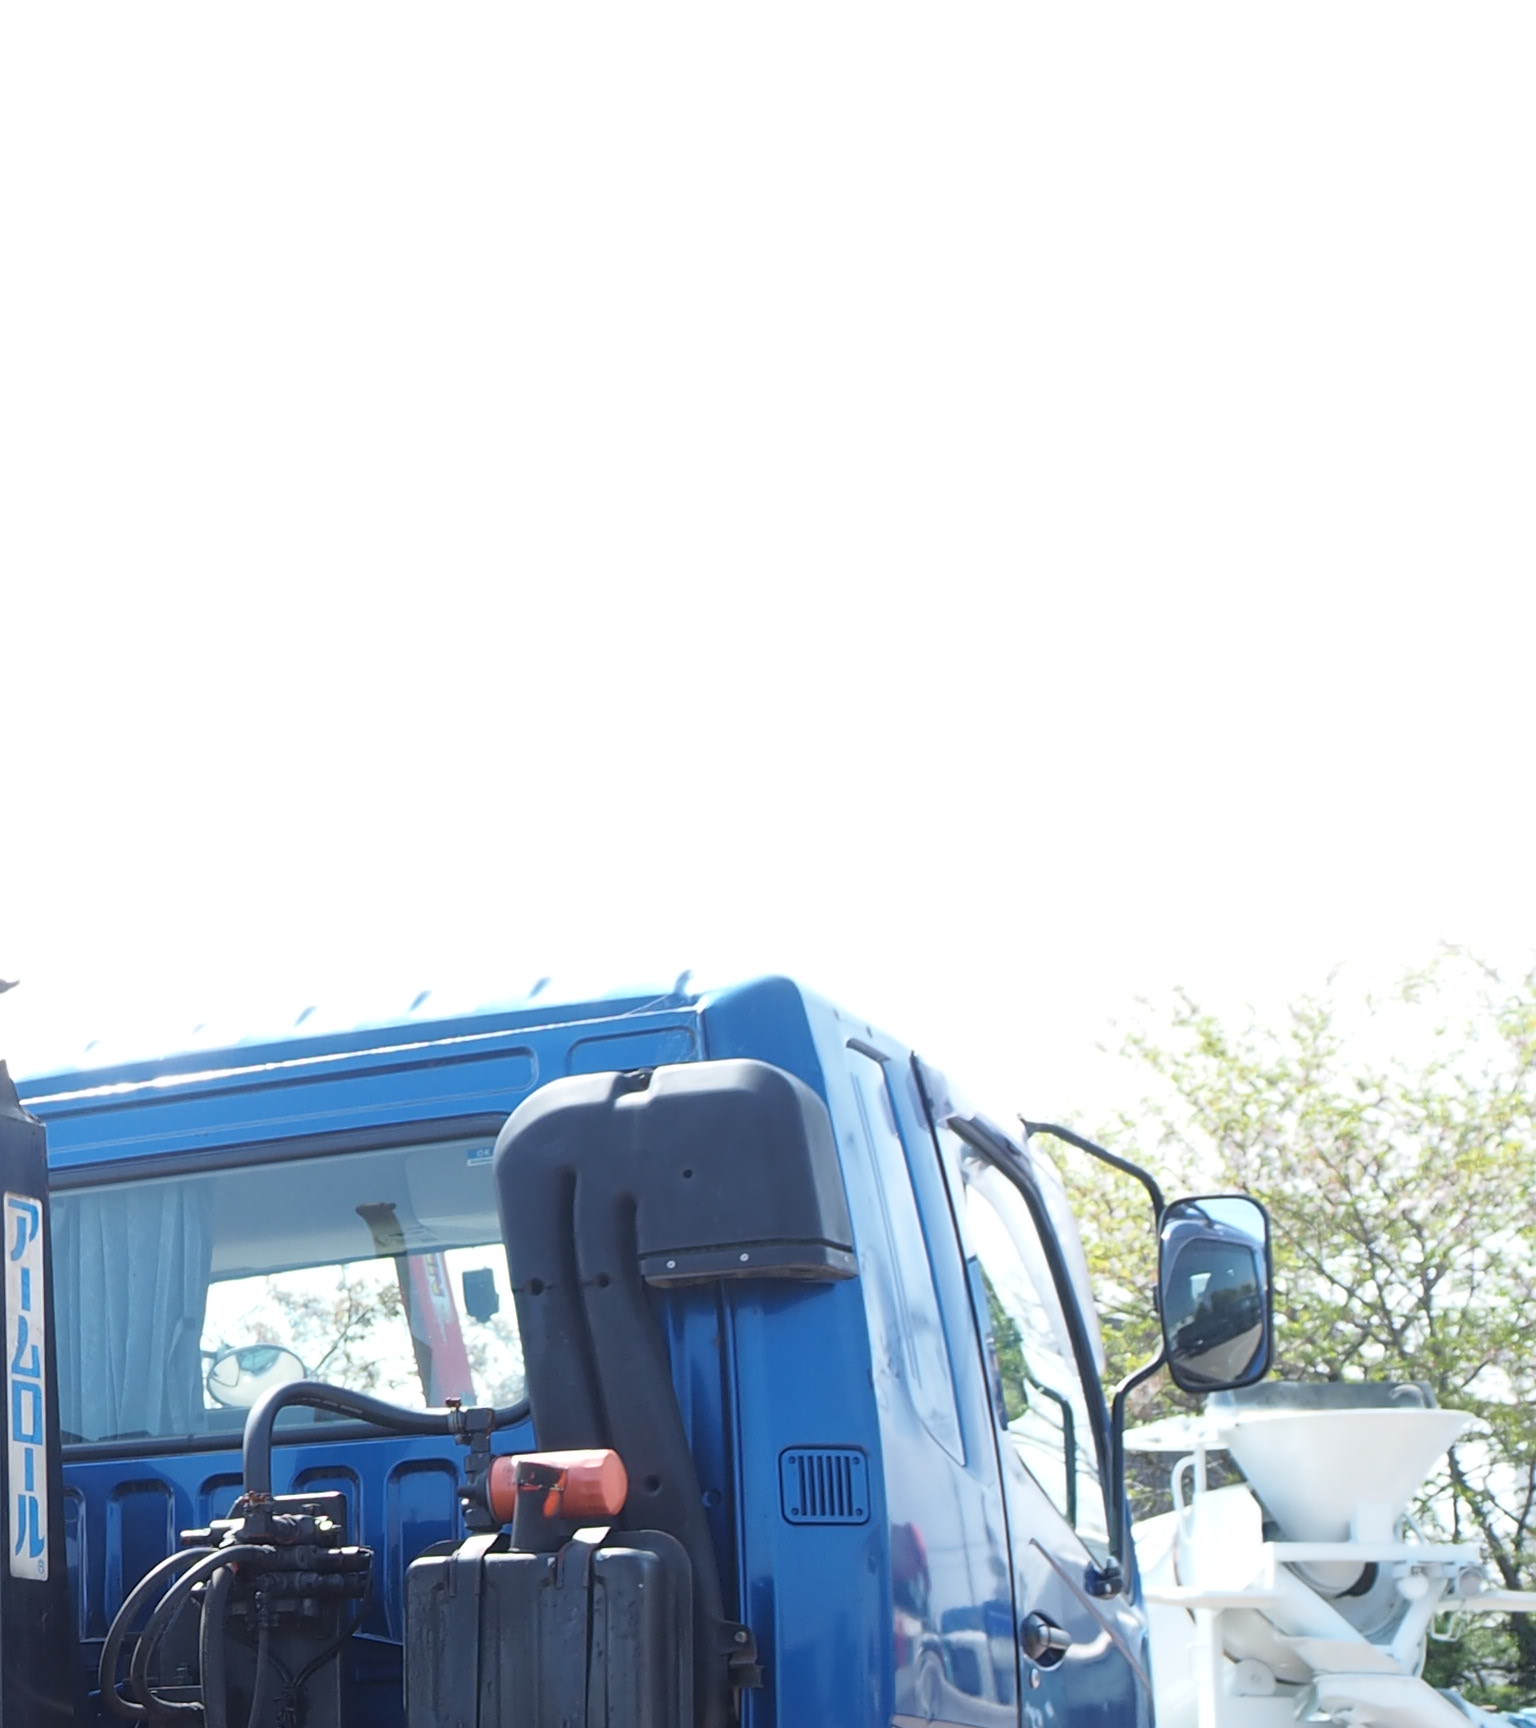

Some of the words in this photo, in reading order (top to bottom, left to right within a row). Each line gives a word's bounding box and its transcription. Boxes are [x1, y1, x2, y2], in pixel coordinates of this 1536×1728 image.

[8, 1200, 45, 1558] アームロール
